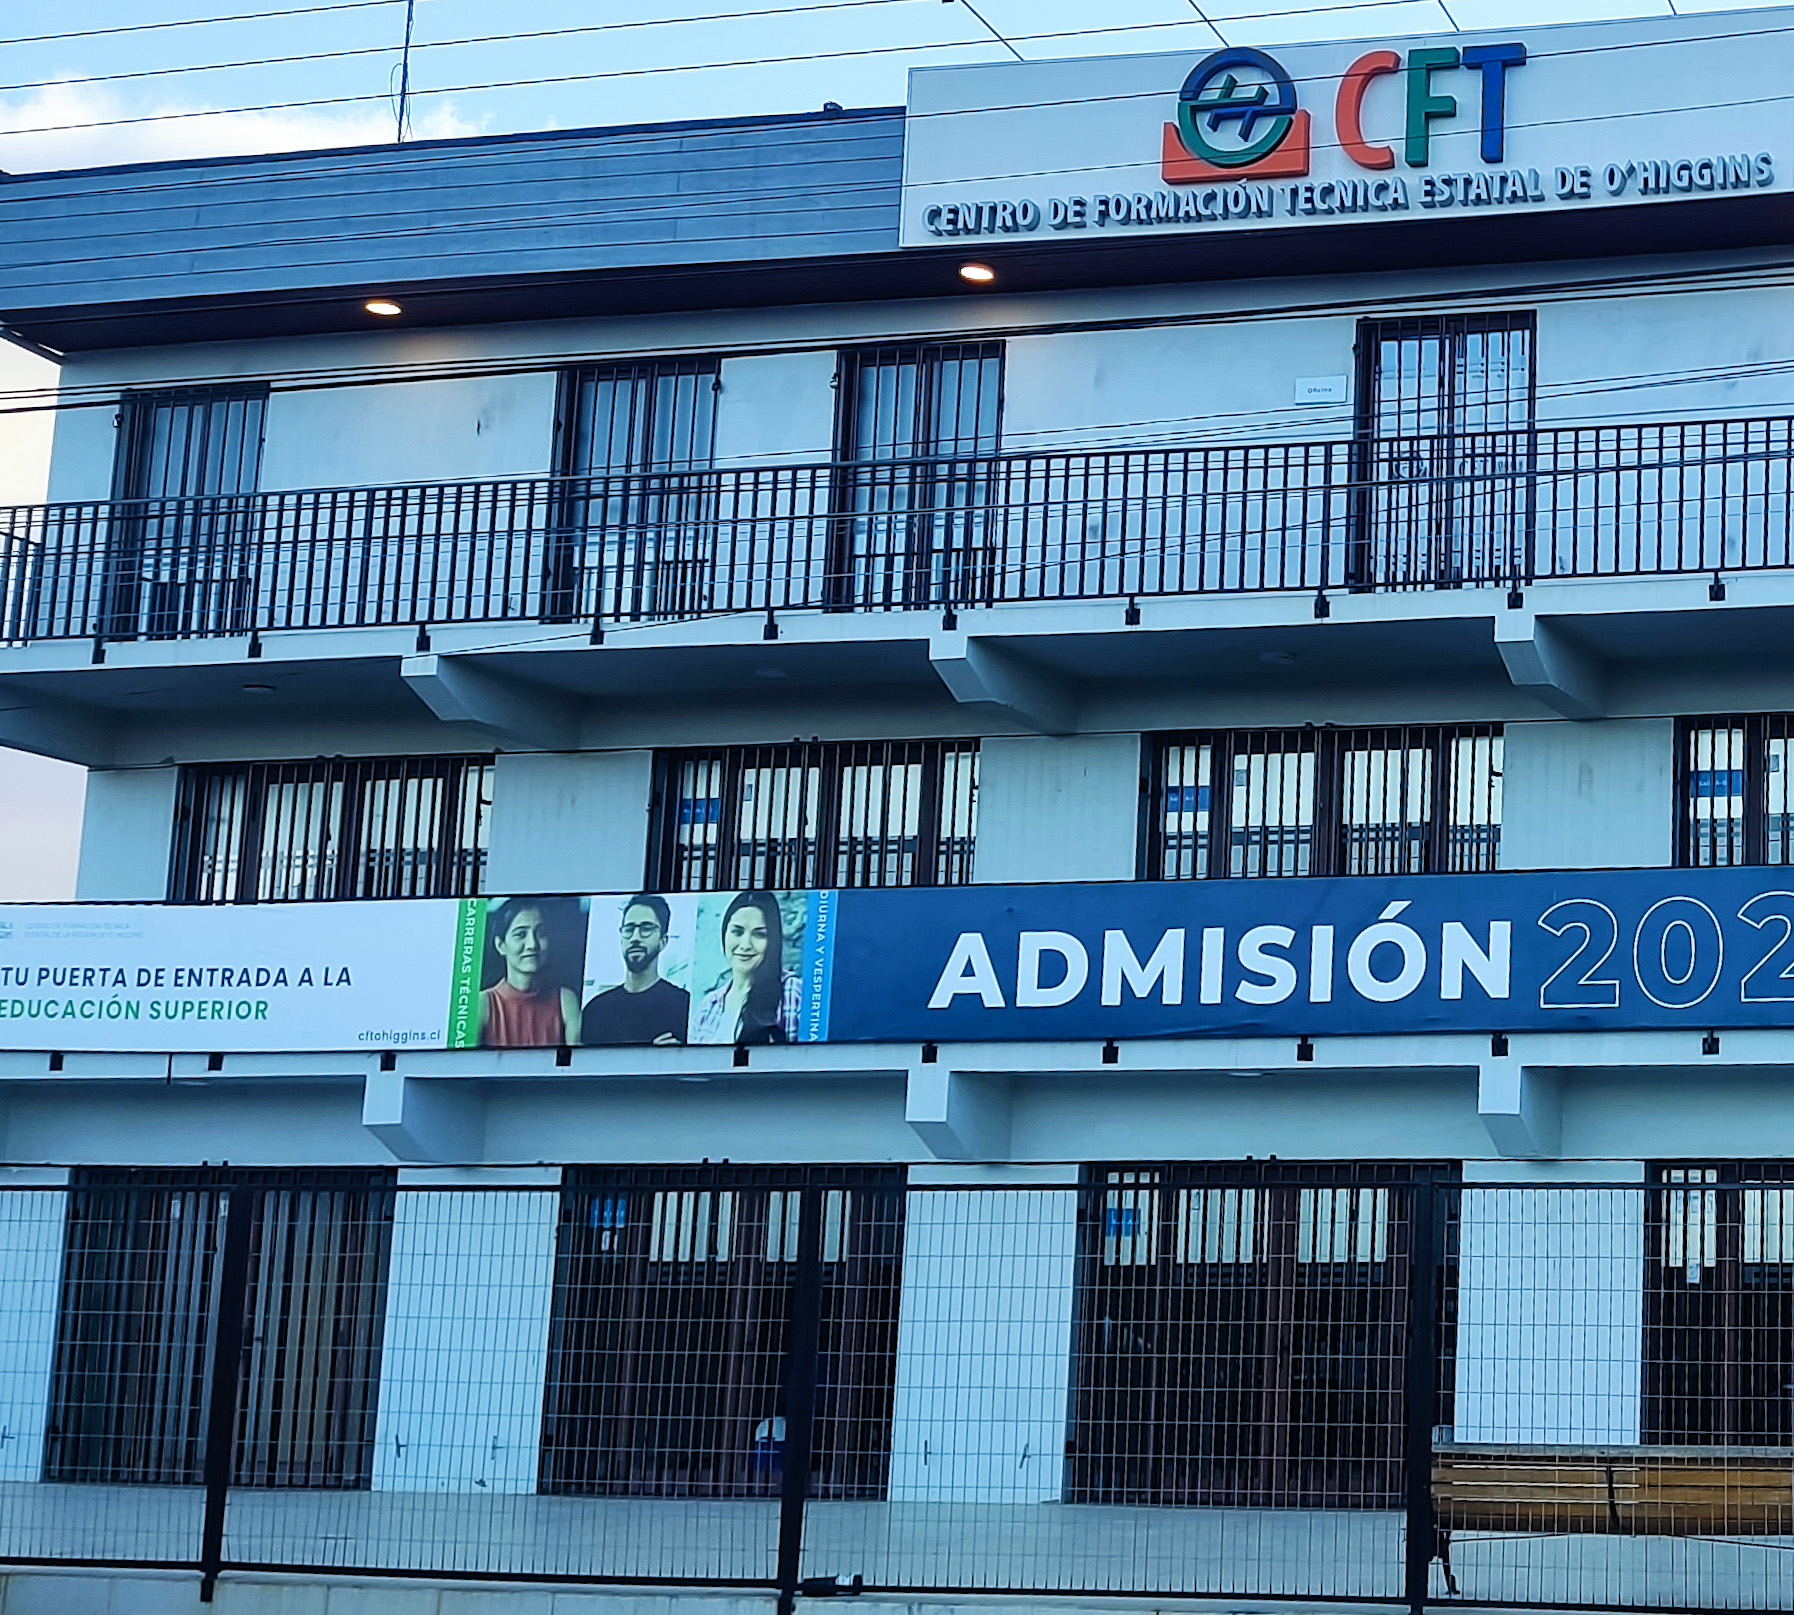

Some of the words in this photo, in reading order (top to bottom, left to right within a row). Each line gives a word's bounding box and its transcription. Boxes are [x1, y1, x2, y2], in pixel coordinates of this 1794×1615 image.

[1335, 42, 1526, 171] CFT
[922, 198, 1040, 236] CENTRO
[1047, 194, 1087, 231] DE
[1092, 178, 1272, 228] FORMACIÓN
[1280, 176, 1407, 216] TECNICA
[1419, 166, 1543, 209] ESTATAL
[1554, 164, 1592, 201] DE
[461, 898, 477, 974] CARRERAS
[815, 945, 825, 955] Y
[816, 890, 829, 943] DIURNA
[1, 966, 29, 987] TU
[36, 967, 127, 987] PUERTA
[135, 967, 166, 987] DE
[173, 967, 289, 988] ENTRADA
[297, 967, 314, 988] A
[322, 967, 352, 987] LA
[926, 899, 1511, 1010] ADMISIÓN
[0, 994, 140, 1020] EDUCACIÓN
[149, 1000, 269, 1021] SUPERIOR
[454, 977, 472, 1049] TÉCNICAS
[808, 957, 825, 1043] VESPERTINA
[358, 1029, 441, 1044] cftohiggins.cl
